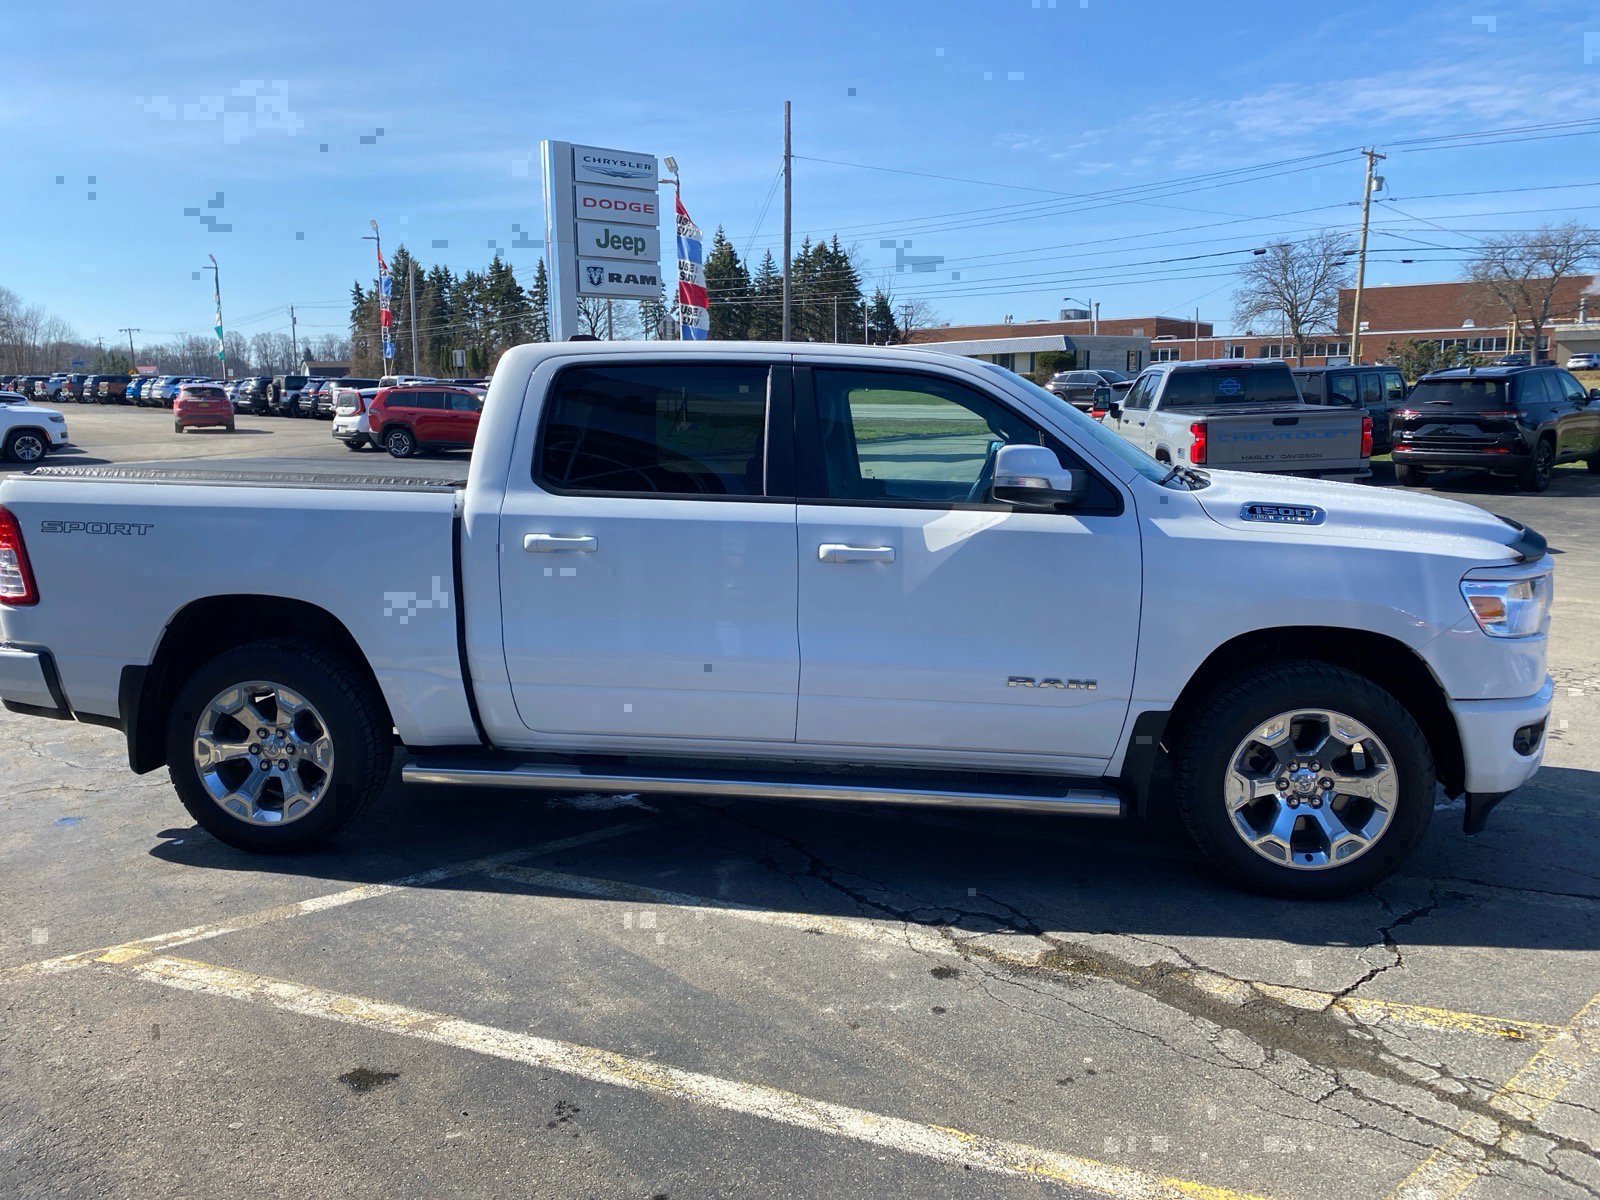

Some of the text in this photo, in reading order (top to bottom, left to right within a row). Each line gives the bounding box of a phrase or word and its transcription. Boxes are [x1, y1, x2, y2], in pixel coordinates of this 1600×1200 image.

[583, 156, 652, 170] CHRYSLER
[583, 197, 655, 214] DODGE
[596, 228, 646, 256] Jeep
[608, 272, 657, 286] RAM
[1217, 430, 1350, 443] CHEVROLET
[1280, 452, 1323, 460] DAVIDSON
[1252, 506, 1312, 517] 1500
[40, 520, 154, 536] SPORT
[1007, 675, 1098, 690] RAM
